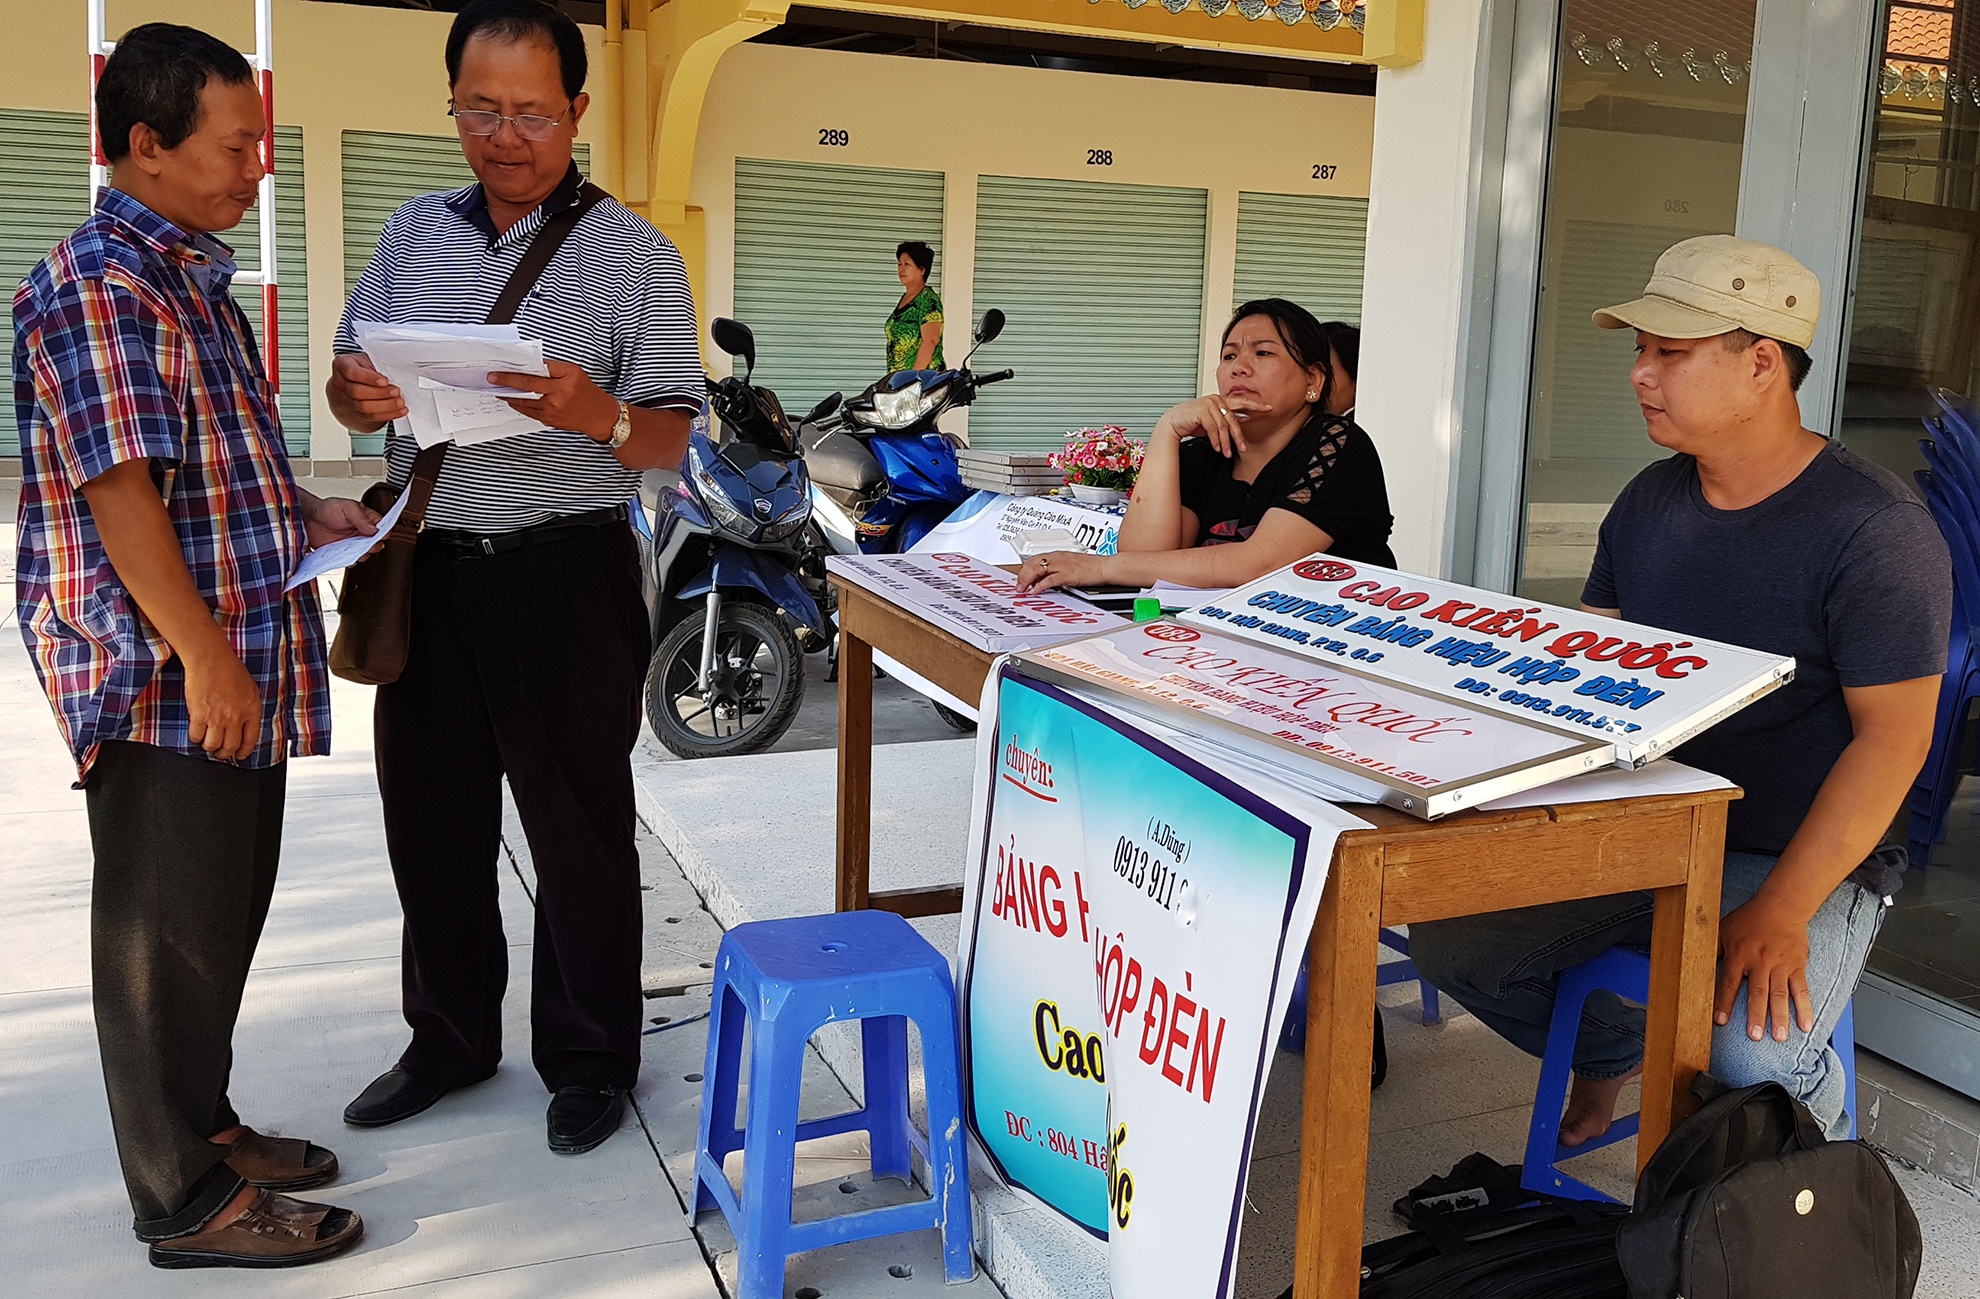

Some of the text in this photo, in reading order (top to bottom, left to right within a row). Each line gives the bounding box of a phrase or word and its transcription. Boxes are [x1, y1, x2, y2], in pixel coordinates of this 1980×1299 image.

[818, 128, 849, 147] 289
[1086, 149, 1113, 166] 288
[1311, 164, 1337, 180] 287
[886, 494, 907, 506] HONDA
[937, 564, 992, 580] CAO
[1012, 600, 1105, 625] QUỐC
[1146, 624, 1194, 642] 089
[1227, 613, 1266, 629] HẬU
[1259, 622, 1311, 646] GIANG,
[1309, 636, 1349, 656] P.12,
[1350, 647, 1385, 664] Q.6
[1247, 590, 1665, 711] CHUYÊN BẢNG HIỆU HỘP ĐÈN
[1338, 580, 1708, 679] CAO KIẾN QUỐC
[1142, 645, 1473, 744] CAO KIẾN QUỐC
[1160, 674, 1216, 693] CHUYÊN
[1203, 688, 1248, 704] BẢNG
[1236, 699, 1283, 715] HIỆU
[1005, 734, 1054, 788] chuyên:
[1305, 740, 1442, 787] 0913.911.507
[1113, 835, 1149, 889] 0913
[1147, 859, 1177, 911] 911
[991, 833, 1068, 938] BẢNG
[1095, 926, 1143, 1047] HỘP
[1139, 970, 1226, 1104] ĐÈN
[1034, 1001, 1106, 1085] Cao
[1003, 1109, 1032, 1142] ĐC
[1047, 1127, 1079, 1161] 804
[1081, 1138, 1109, 1177] Hậ
